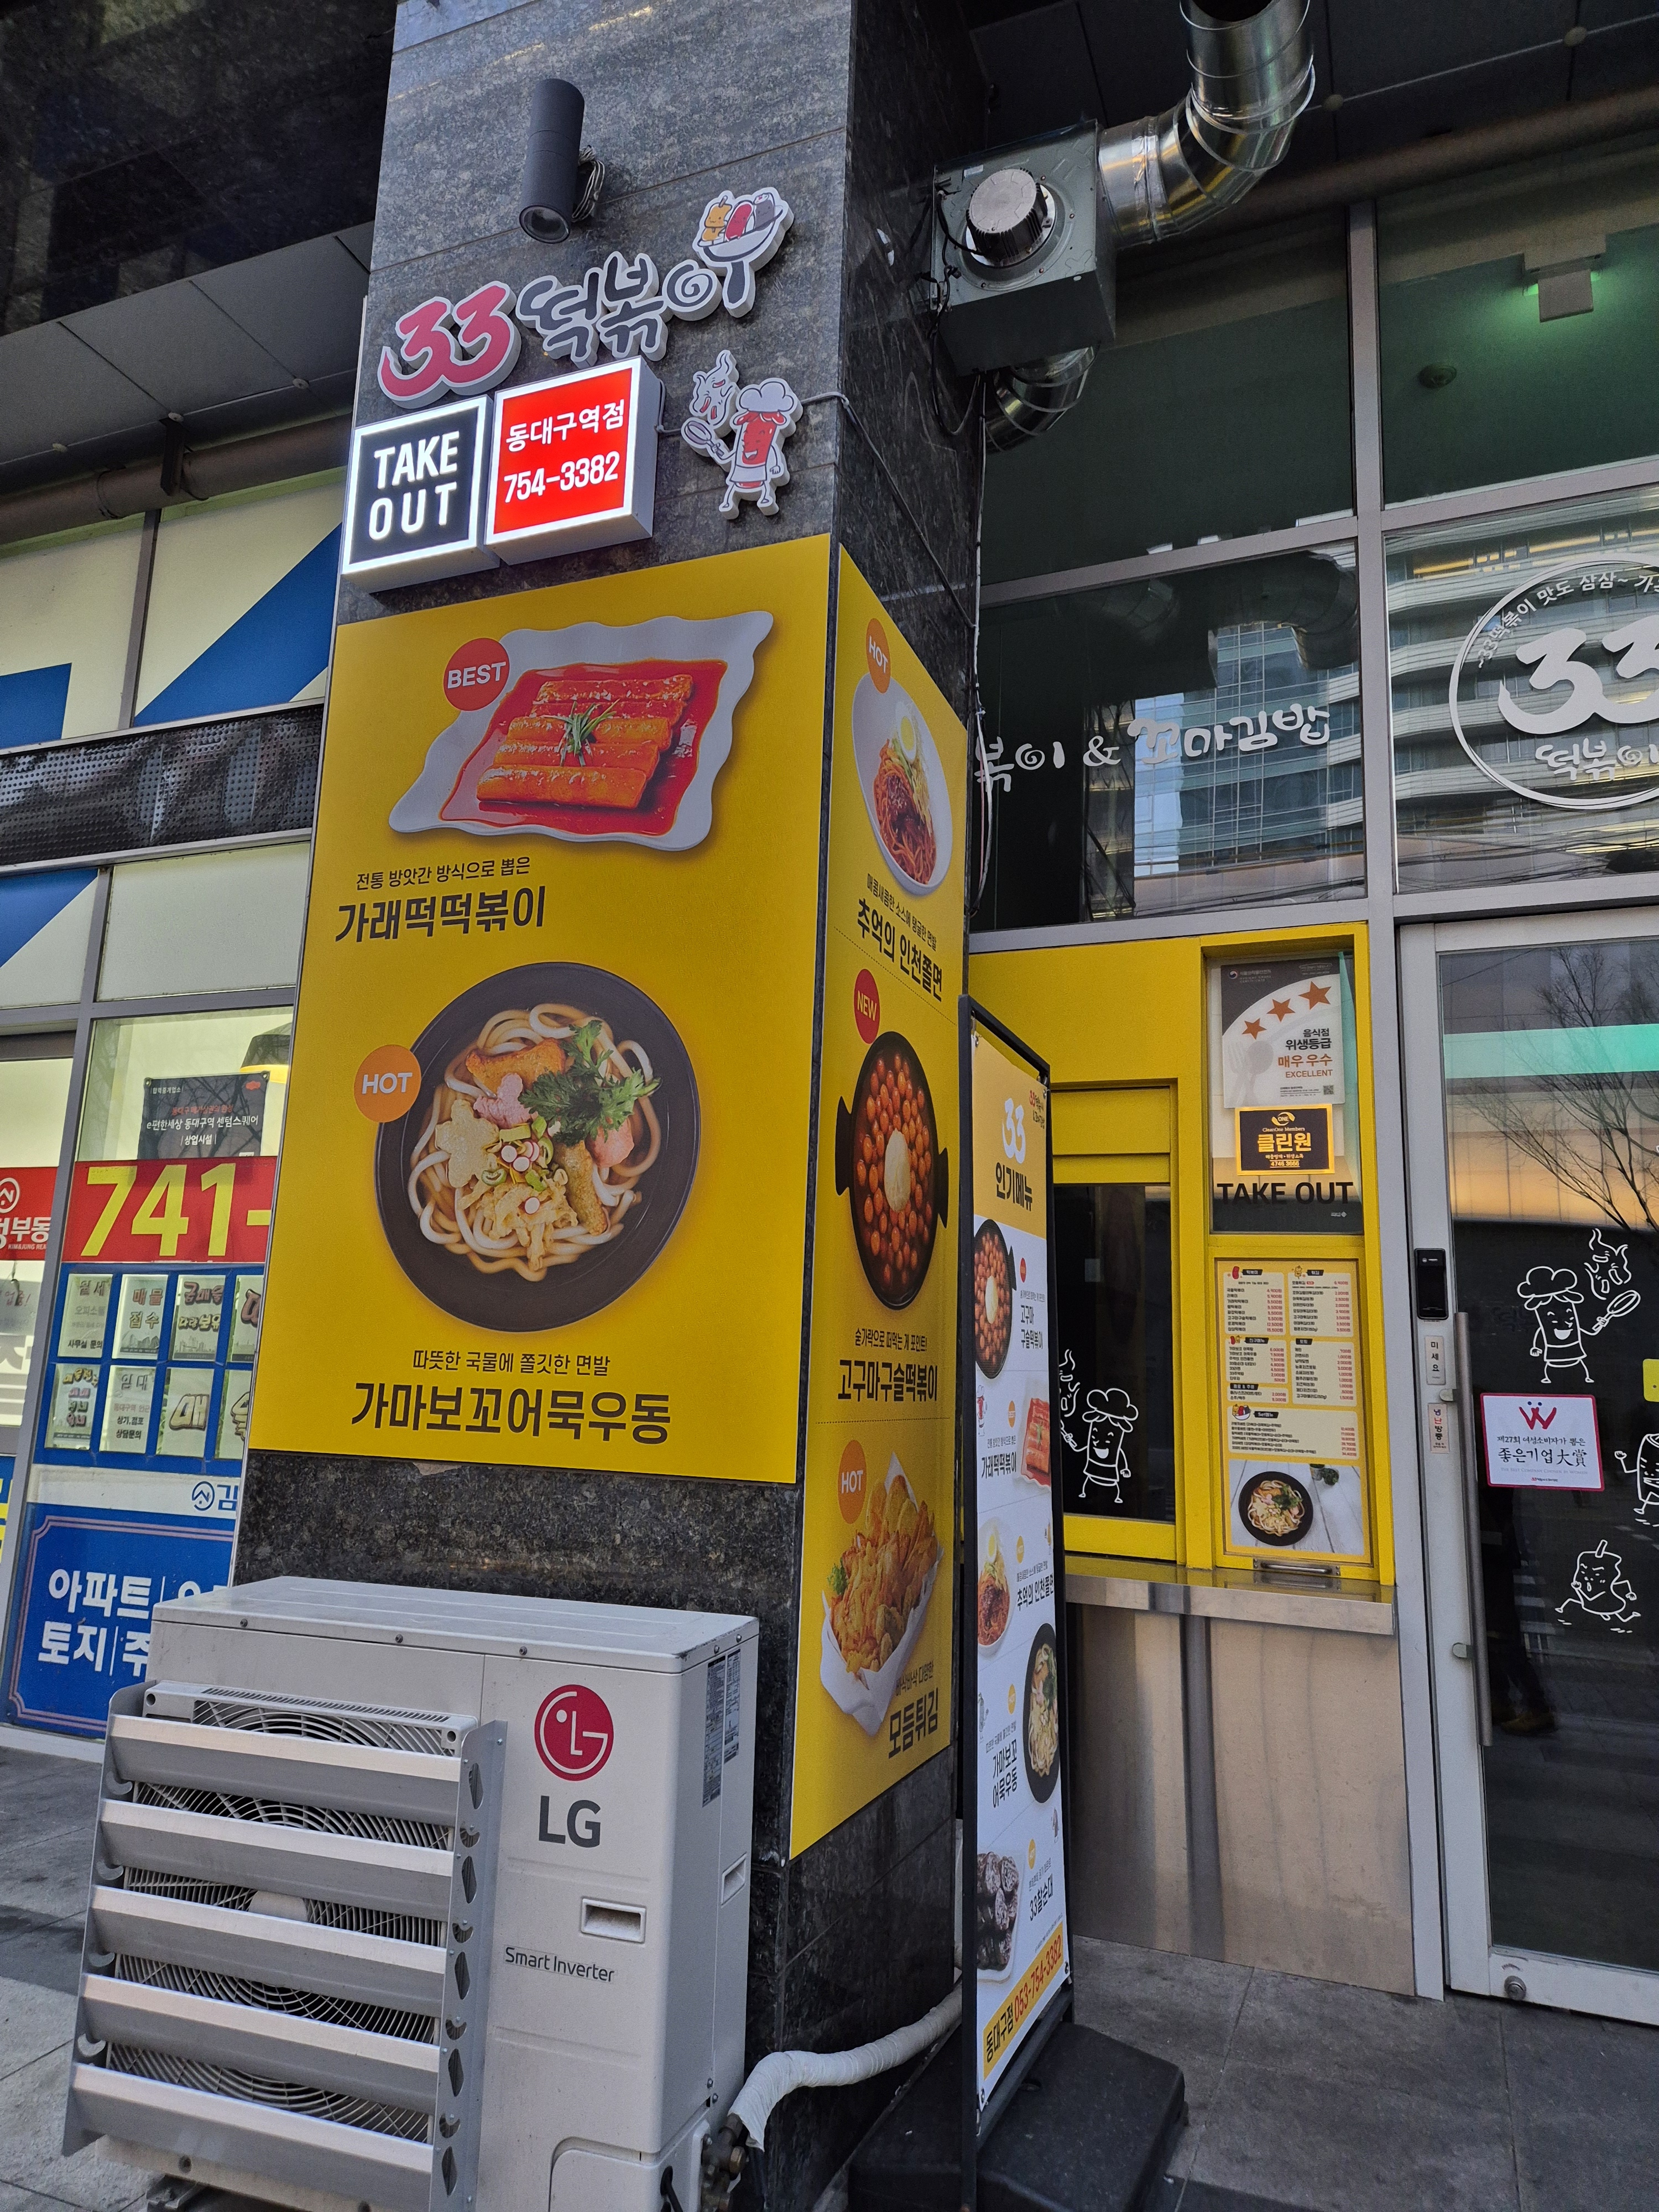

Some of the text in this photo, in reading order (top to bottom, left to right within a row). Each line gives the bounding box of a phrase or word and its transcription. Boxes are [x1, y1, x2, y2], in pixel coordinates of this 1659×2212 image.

[505, 398, 625, 453] 동대구역점
[373, 431, 459, 491] TAKE
[503, 450, 620, 504] 754-3382
[368, 482, 458, 542] OUT
[1537, 580, 1574, 606] 맛도
[868, 635, 889, 674] HOT
[447, 661, 506, 690] BEST
[1083, 735, 1121, 767] &
[1127, 703, 1330, 764] 꼬마김밥
[356, 857, 531, 891] 전통 방앗간 방식으로 뽑은
[335, 885, 546, 943] 가래떡떡볶이
[857, 898, 942, 1002] 추억의 인천쫄면
[857, 990, 877, 1022] NEW
[1285, 1038, 1332, 1051] 위생등급
[1303, 1028, 1330, 1038] 음식점
[1277, 1053, 1333, 1068] 매우 우수
[1285, 1069, 1333, 1078] EXCELLENT
[362, 1071, 413, 1094] HOT
[147, 1115, 258, 1130] e편한세상 동대구역 센텀스퀘어
[1001, 1097, 1026, 1165] 33
[185, 1134, 213, 1146] 상업시설
[1257, 1132, 1312, 1153] 클린원
[995, 1161, 1033, 1212] 인기메뉴
[1217, 1181, 1354, 1204] TAKE OUT
[0, 1217, 51, 1250] 부동
[1020, 1305, 1034, 1325] 고구마
[855, 1328, 927, 1352] 숟가락으로 떠먹는 게 포인트!
[1021, 1329, 1043, 1349] 구슬떡볶이
[413, 1348, 611, 1376] 따뜻한 국물에 쫄깃한 면발
[838, 1359, 938, 1402] 고구마구슬떡볶이
[351, 1382, 671, 1445] 가마보꼬어묵우동
[1497, 1436, 1521, 1444] 제27회
[1522, 1436, 1567, 1445] 여성소비자가
[982, 1451, 1017, 1479] 가래떡떡볶이
[1498, 1447, 1588, 1468] 좋은기업 大賞
[841, 1470, 864, 1494] HOT
[48, 1568, 153, 1620] 아파트
[1017, 1585, 1033, 1611] 추억의
[38, 1620, 108, 1672] 토지
[888, 1687, 938, 1759] 모듬튀김
[993, 1738, 1017, 1780] 가마보꼬
[993, 1766, 1018, 1809] 어묵우동
[539, 1795, 601, 1848] LG
[505, 1946, 614, 1983] Smart Inverter
[986, 2002, 1013, 2064] 동대구점
[1014, 1934, 1062, 2023] 053-754-3382
